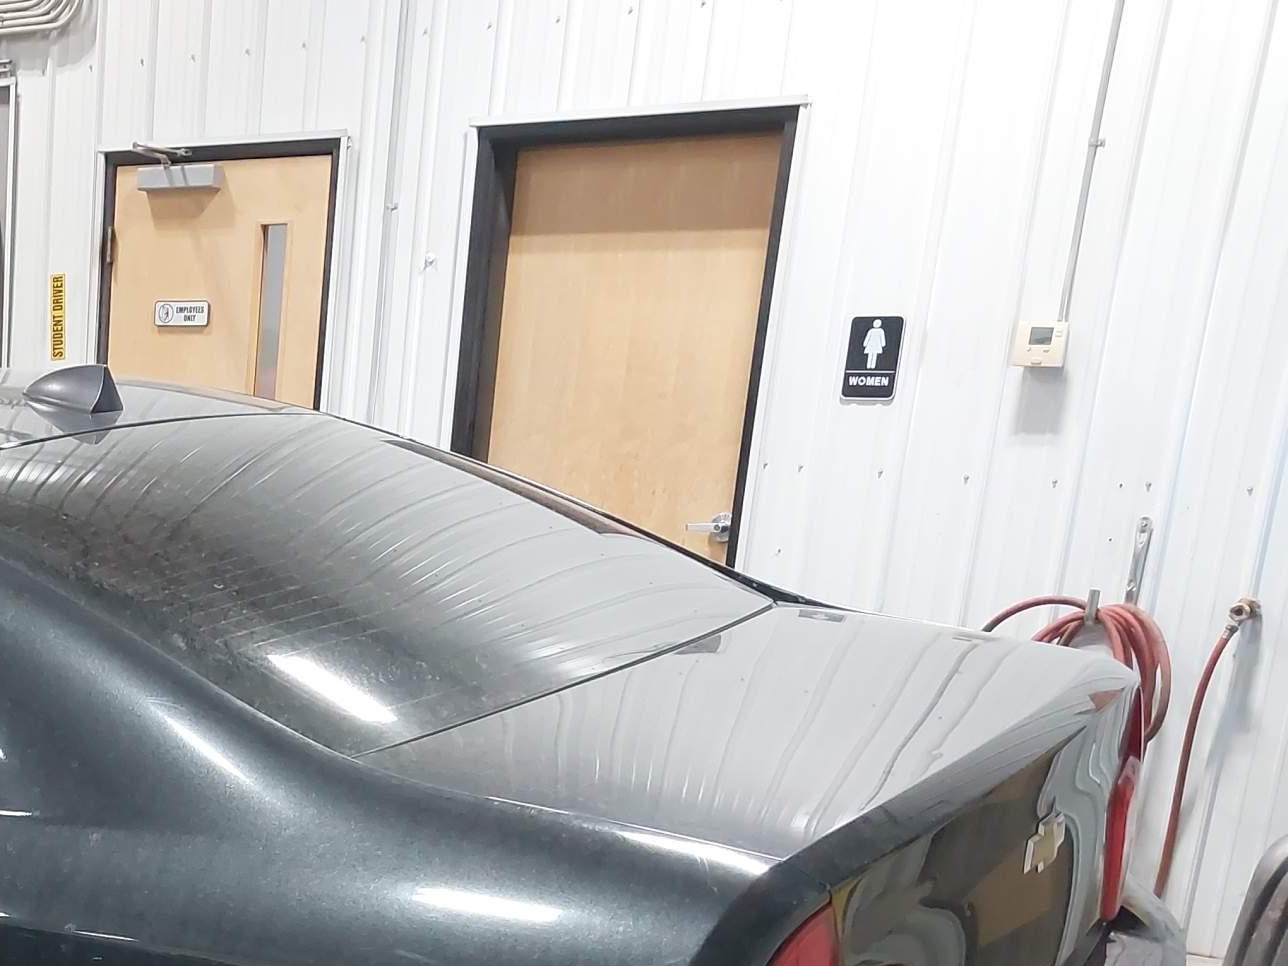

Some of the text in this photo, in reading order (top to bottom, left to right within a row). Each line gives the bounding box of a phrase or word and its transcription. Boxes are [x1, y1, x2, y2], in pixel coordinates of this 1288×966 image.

[175, 306, 205, 314] EMPLOYEES
[52, 275, 64, 358] STUDENT DRIVER
[183, 314, 197, 322] ONLY
[848, 375, 889, 387] WOMEN
